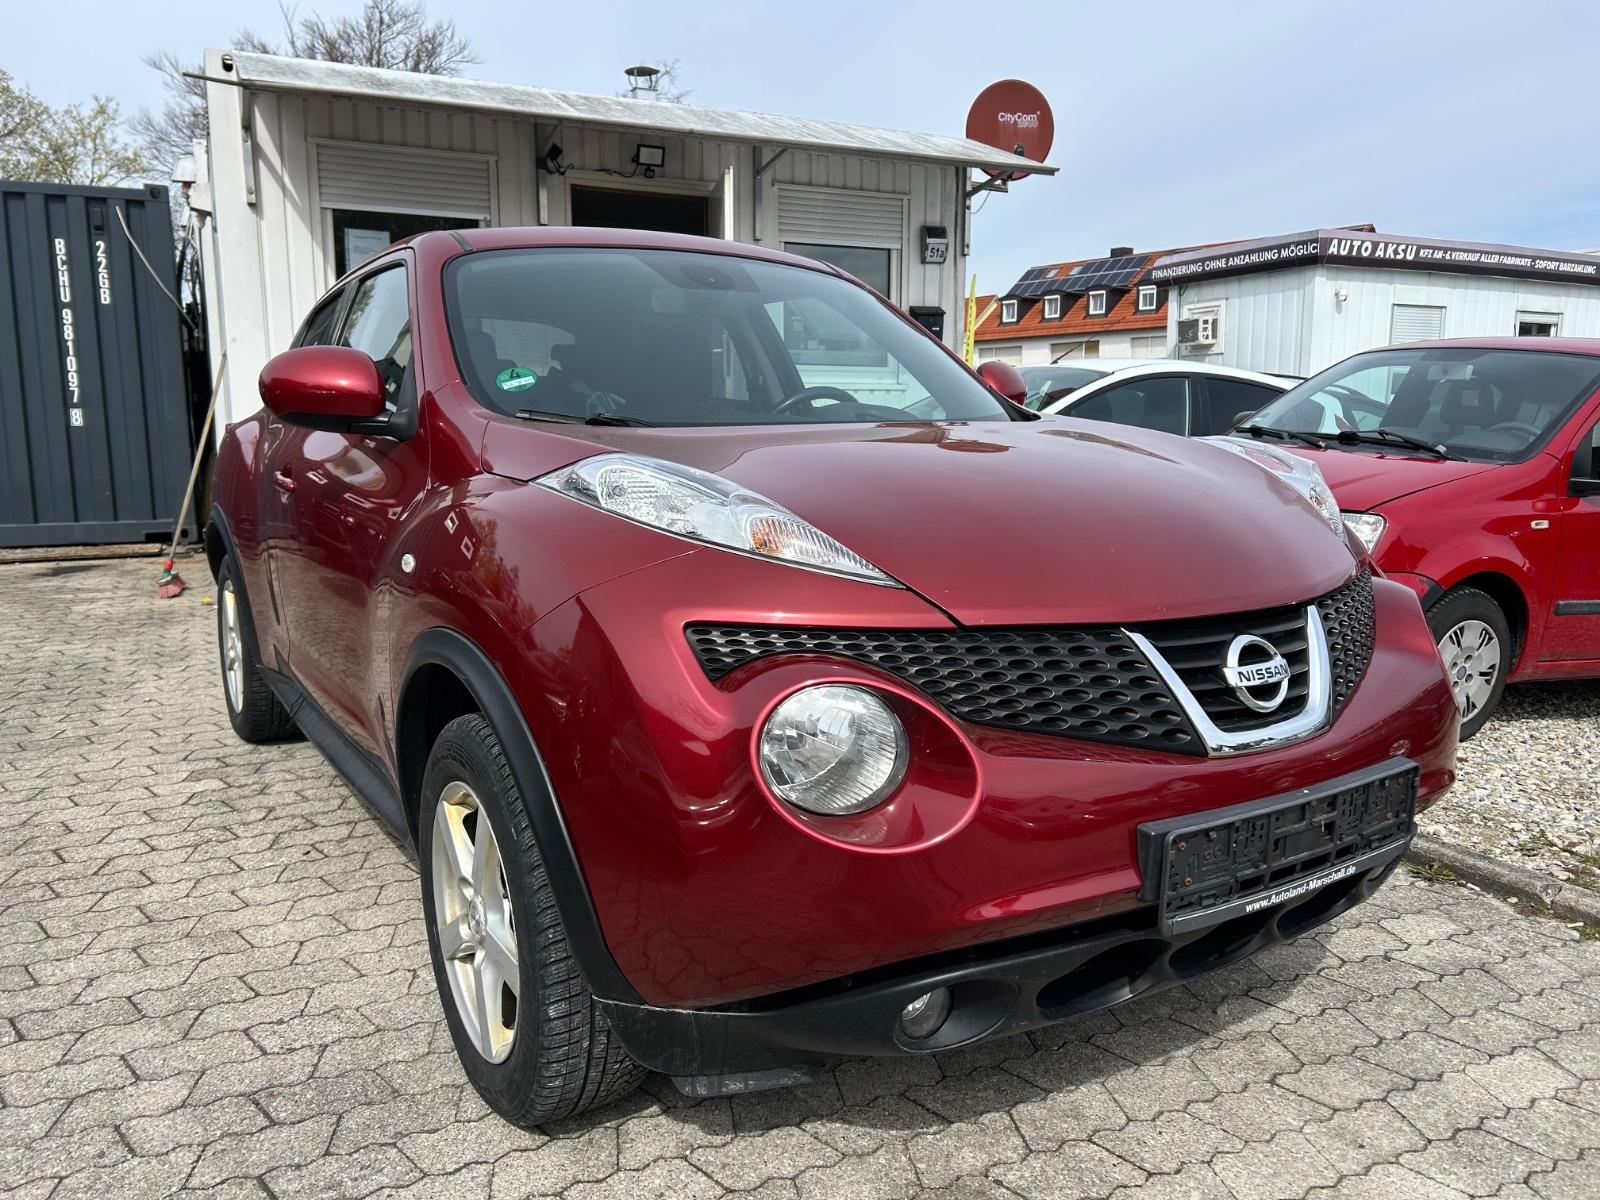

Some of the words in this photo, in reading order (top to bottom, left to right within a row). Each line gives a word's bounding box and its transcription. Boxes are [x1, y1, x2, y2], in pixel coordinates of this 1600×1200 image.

[929, 247, 945, 259] 51a
[1328, 239, 1373, 257] AUTO
[1375, 242, 1417, 260] AKSU
[1419, 248, 1434, 258] KFZ
[1451, 251, 1482, 262] VERKAUF
[1480, 253, 1500, 263] ALLER
[1499, 255, 1532, 267] FABRIKATE
[1534, 259, 1560, 270] SOFORT
[1559, 262, 1597, 274] BARZAHLUNG
[54, 238, 71, 302] BCHU
[95, 241, 110, 304] 22GB
[1152, 263, 1203, 279] FINANZIERUNG
[1204, 258, 1227, 270] OHNE
[1228, 249, 1279, 267] ANZAHLUNG
[62, 308, 78, 403] 981097
[71, 409, 82, 426] 8
[1237, 663, 1289, 683] NISSAN
[1245, 865, 1356, 913] www.Autoland-Marschall.de
